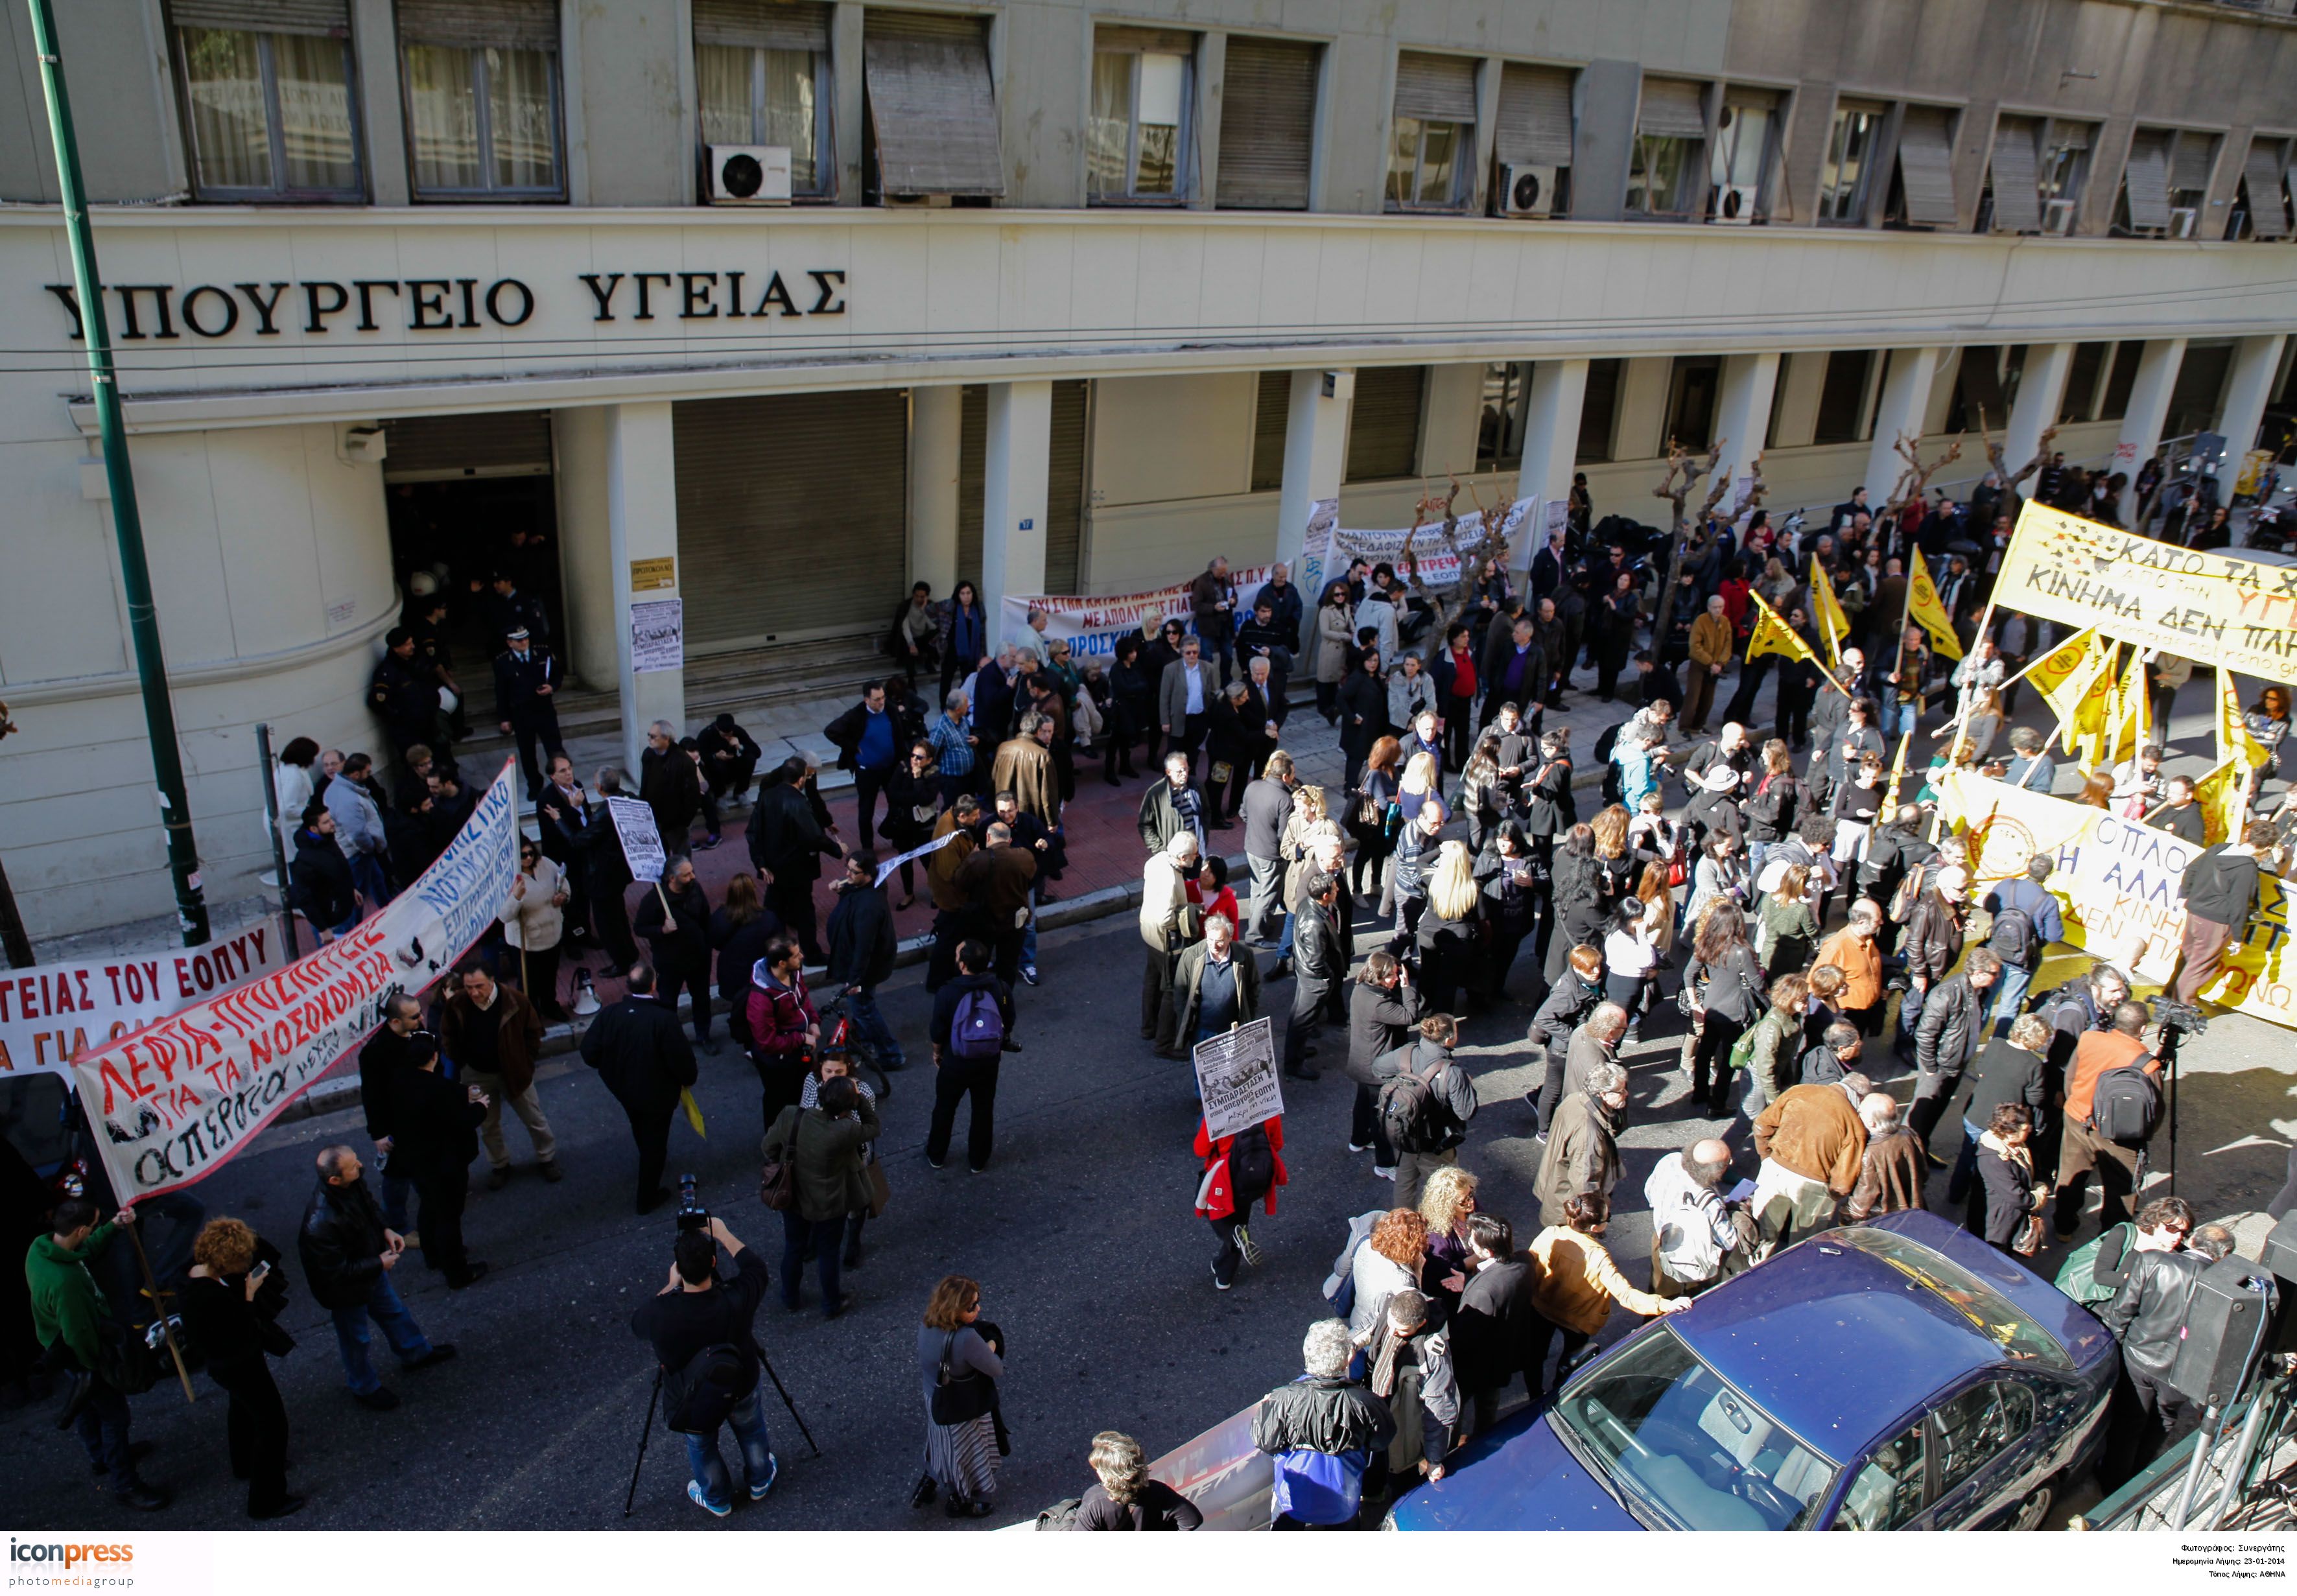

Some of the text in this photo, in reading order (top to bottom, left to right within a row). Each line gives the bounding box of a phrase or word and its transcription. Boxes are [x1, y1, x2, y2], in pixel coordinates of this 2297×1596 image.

[44, 270, 845, 340] ΥΠΟΥΡΓΕΙΟ ΥΓΕΙΑΣ
[2224, 560, 2261, 590] ΤΑ
[1082, 612, 1101, 629] ΜΕ
[2025, 563, 2141, 621] ΚΙΝΗΜΑ
[2158, 605, 2228, 641] ΔΕΝ
[2057, 843, 2080, 874] Η
[2097, 816, 2187, 874] ΟΠΛΟ
[2064, 902, 2125, 940] ΔΕΝ
[104, 961, 161, 1006] ΤΟΥ
[174, 927, 267, 998] ΕΟΠΥΥ
[33, 1026, 90, 1066] ΓΙΑ
[150, 1083, 203, 1131] ΓΙΑ
[204, 1055, 242, 1096] ΤΑ
[1207, 1073, 1264, 1110] ΣΥΜΠΑΡΑΣΤΑΣΗ
[1255, 1081, 1276, 1099] ΕΟΠΥΥ
